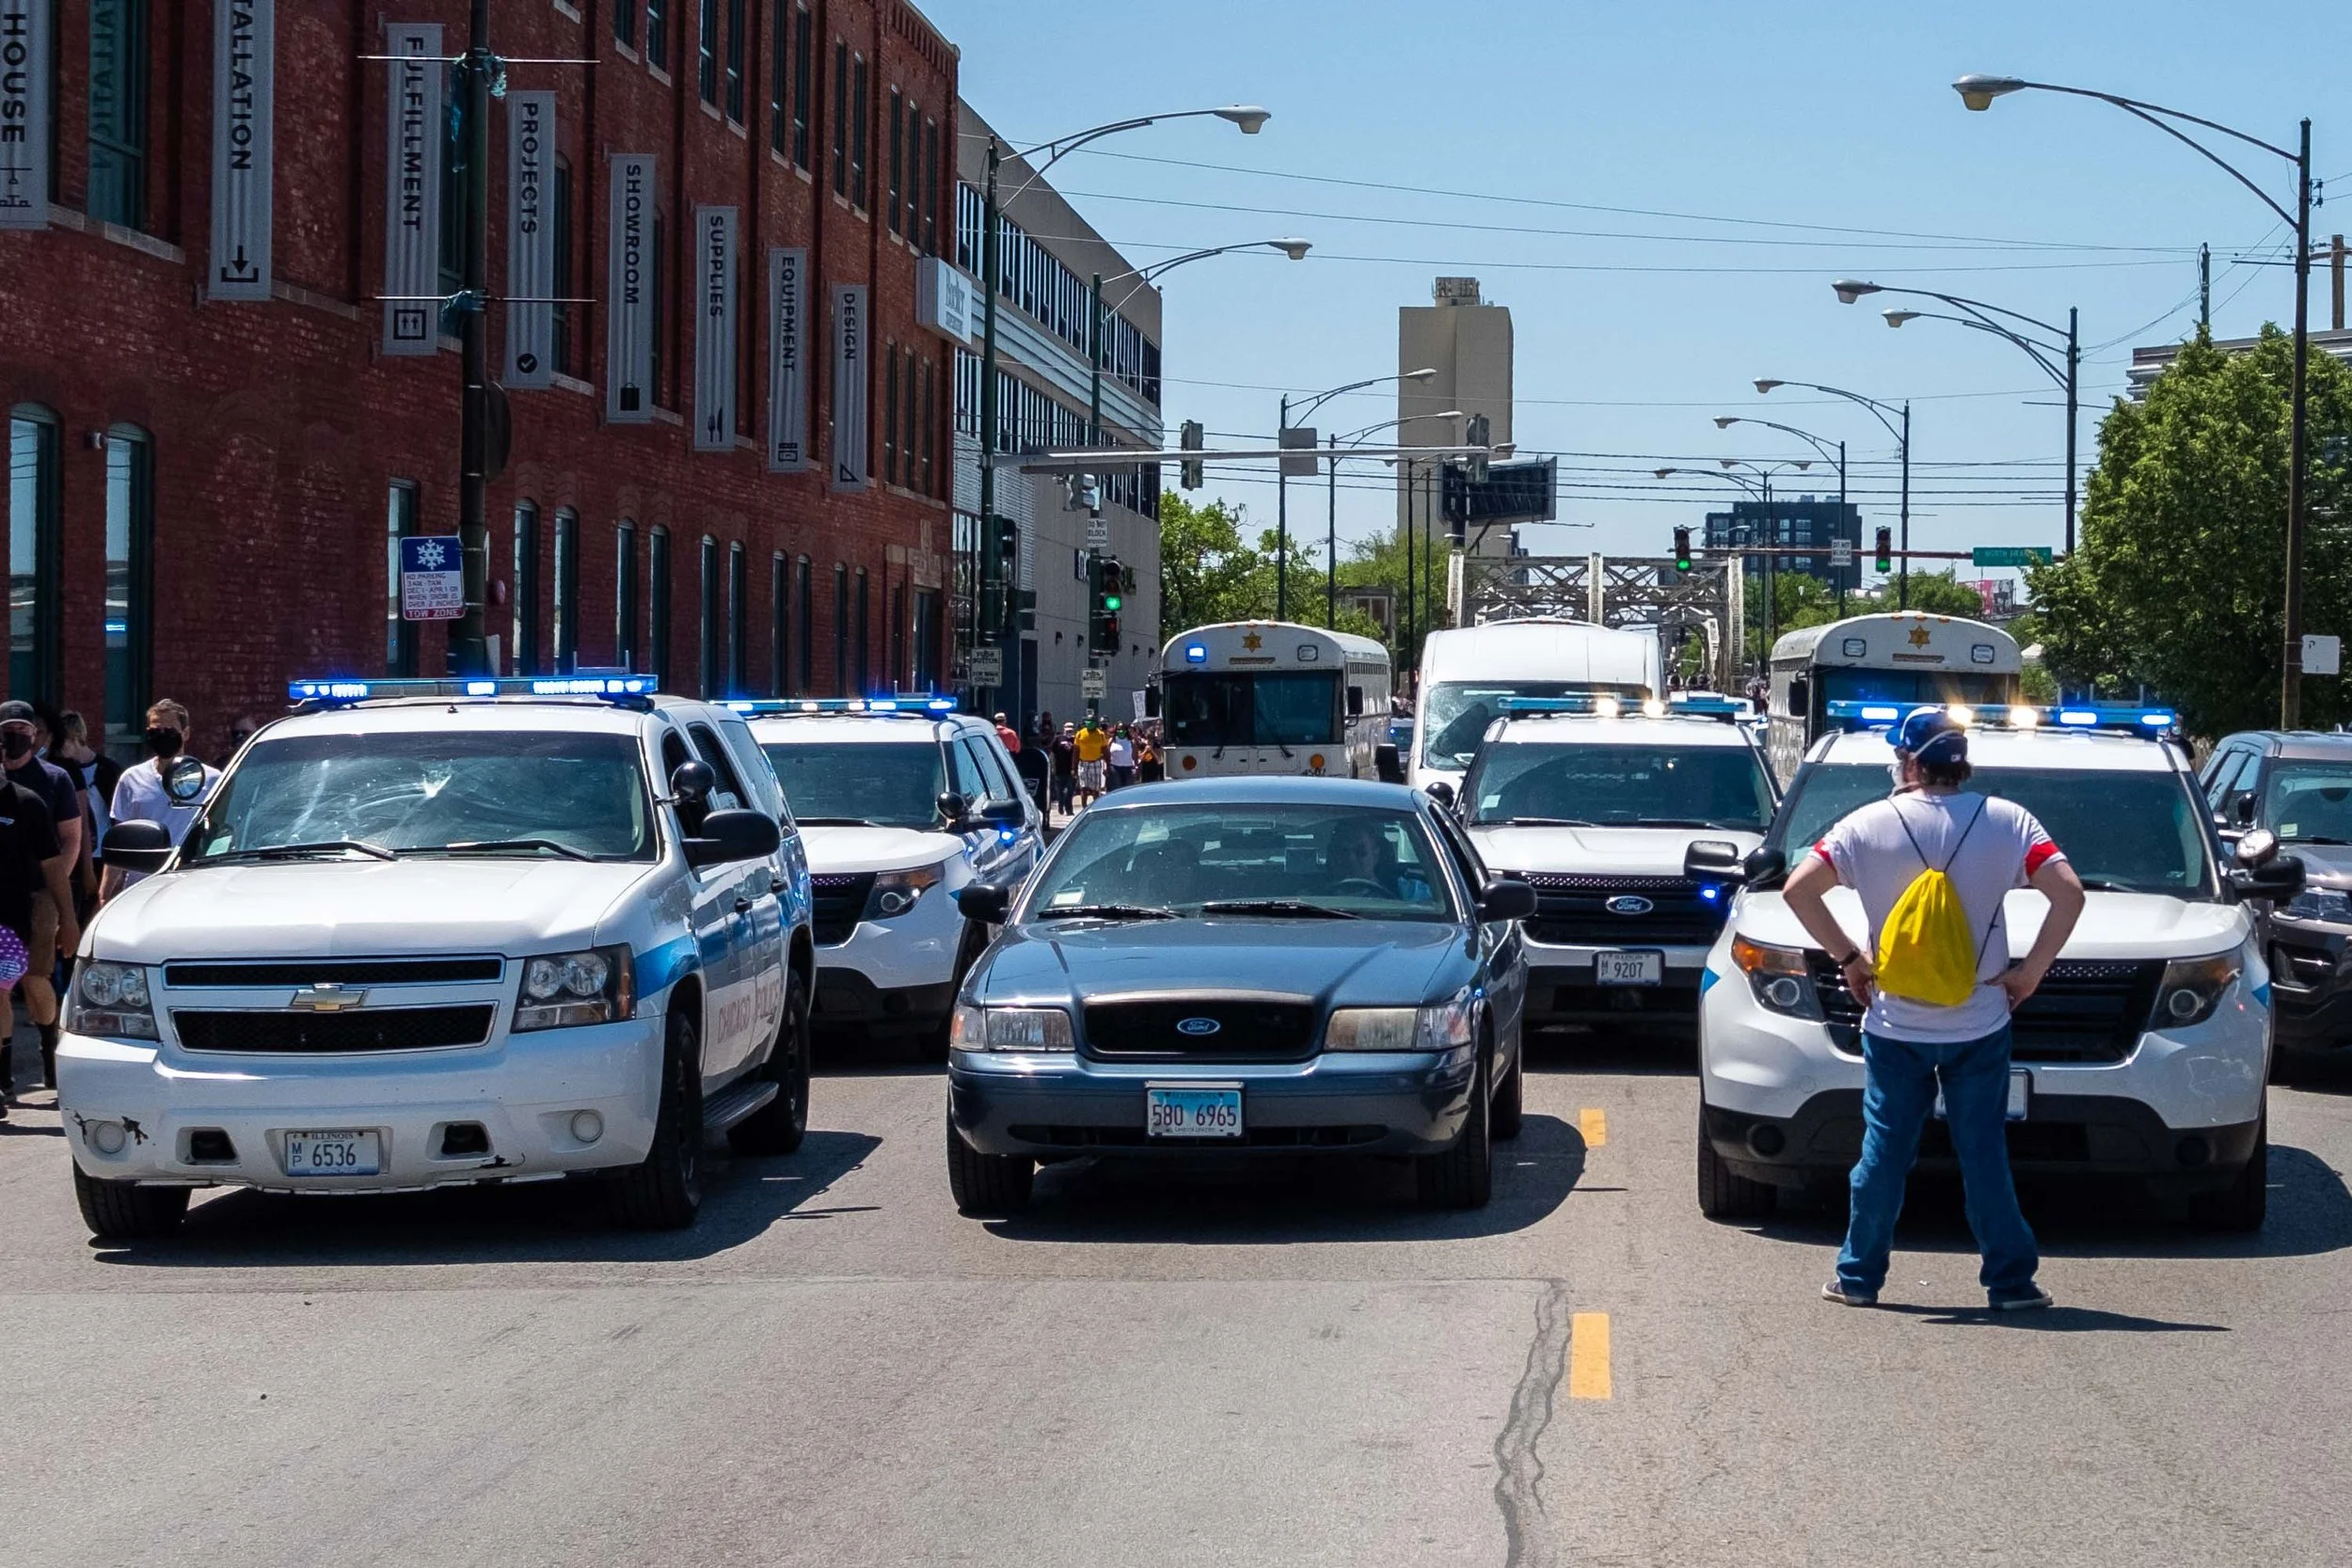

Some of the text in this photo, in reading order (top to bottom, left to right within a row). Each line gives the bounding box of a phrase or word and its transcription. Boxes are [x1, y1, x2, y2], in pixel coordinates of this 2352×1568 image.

[2, 13, 27, 143] HOUSE
[403, 37, 424, 230] FULFILLMENT
[521, 103, 539, 234] PROJECTS
[625, 164, 642, 304] SHOWROOM
[709, 215, 724, 317] SUPPLIES
[782, 257, 795, 372] EQUIPMENT
[844, 293, 856, 359] DESIGN
[433, 609, 459, 617] ZONE
[1616, 899, 1642, 911] Ford
[1614, 961, 1644, 979] 9207
[718, 995, 750, 1044] CHICAGO
[1187, 1021, 1210, 1031] Ford
[1152, 1104, 1237, 1127] 580 6965
[312, 1143, 357, 1167] 6536
